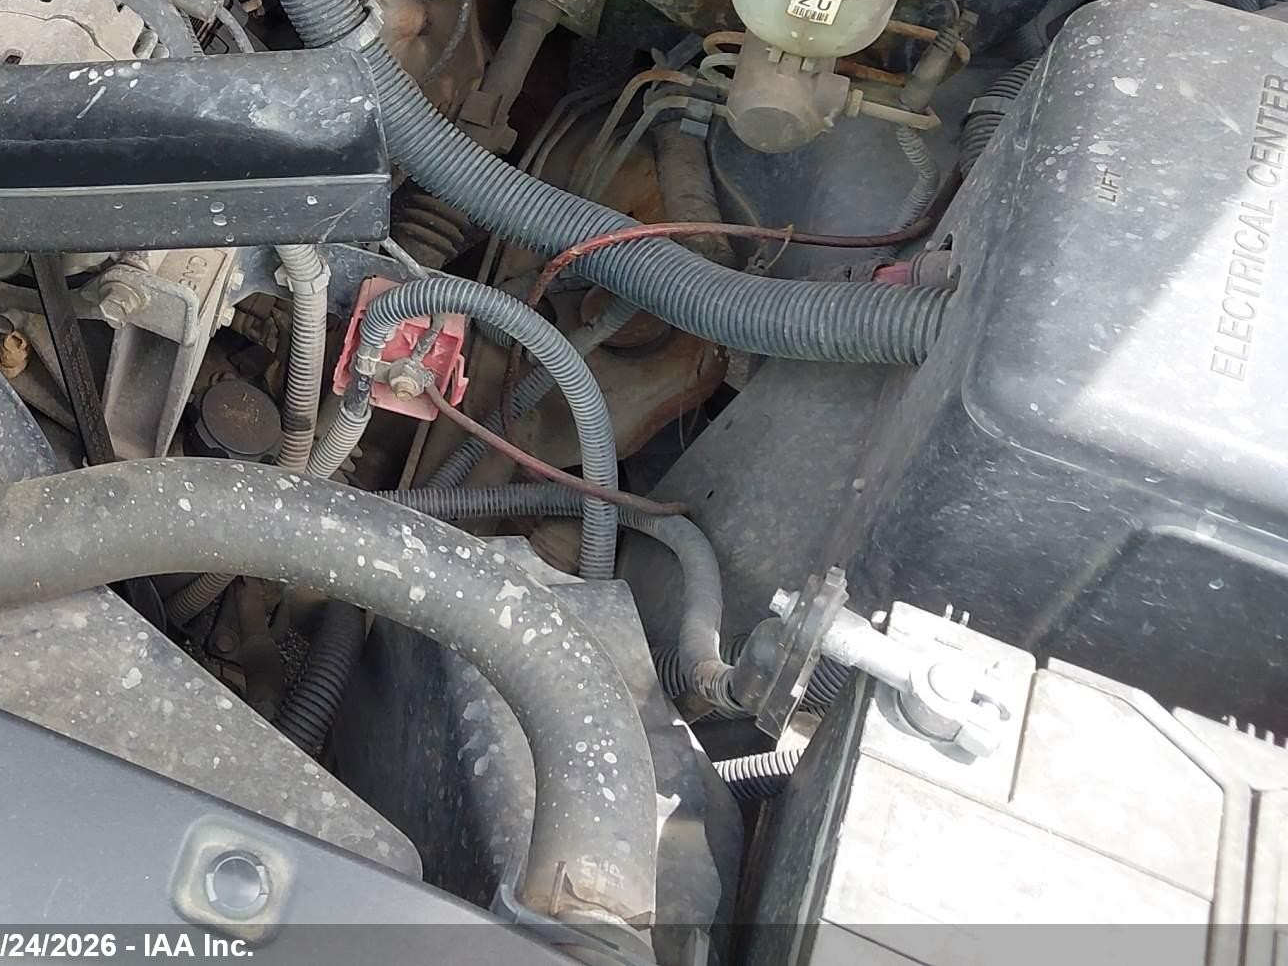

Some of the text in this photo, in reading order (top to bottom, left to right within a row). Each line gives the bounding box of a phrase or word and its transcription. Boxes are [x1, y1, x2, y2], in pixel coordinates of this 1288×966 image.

[1097, 168, 1121, 202] LIFT
[1210, 74, 1288, 381] ELECTRICAL CENTER
